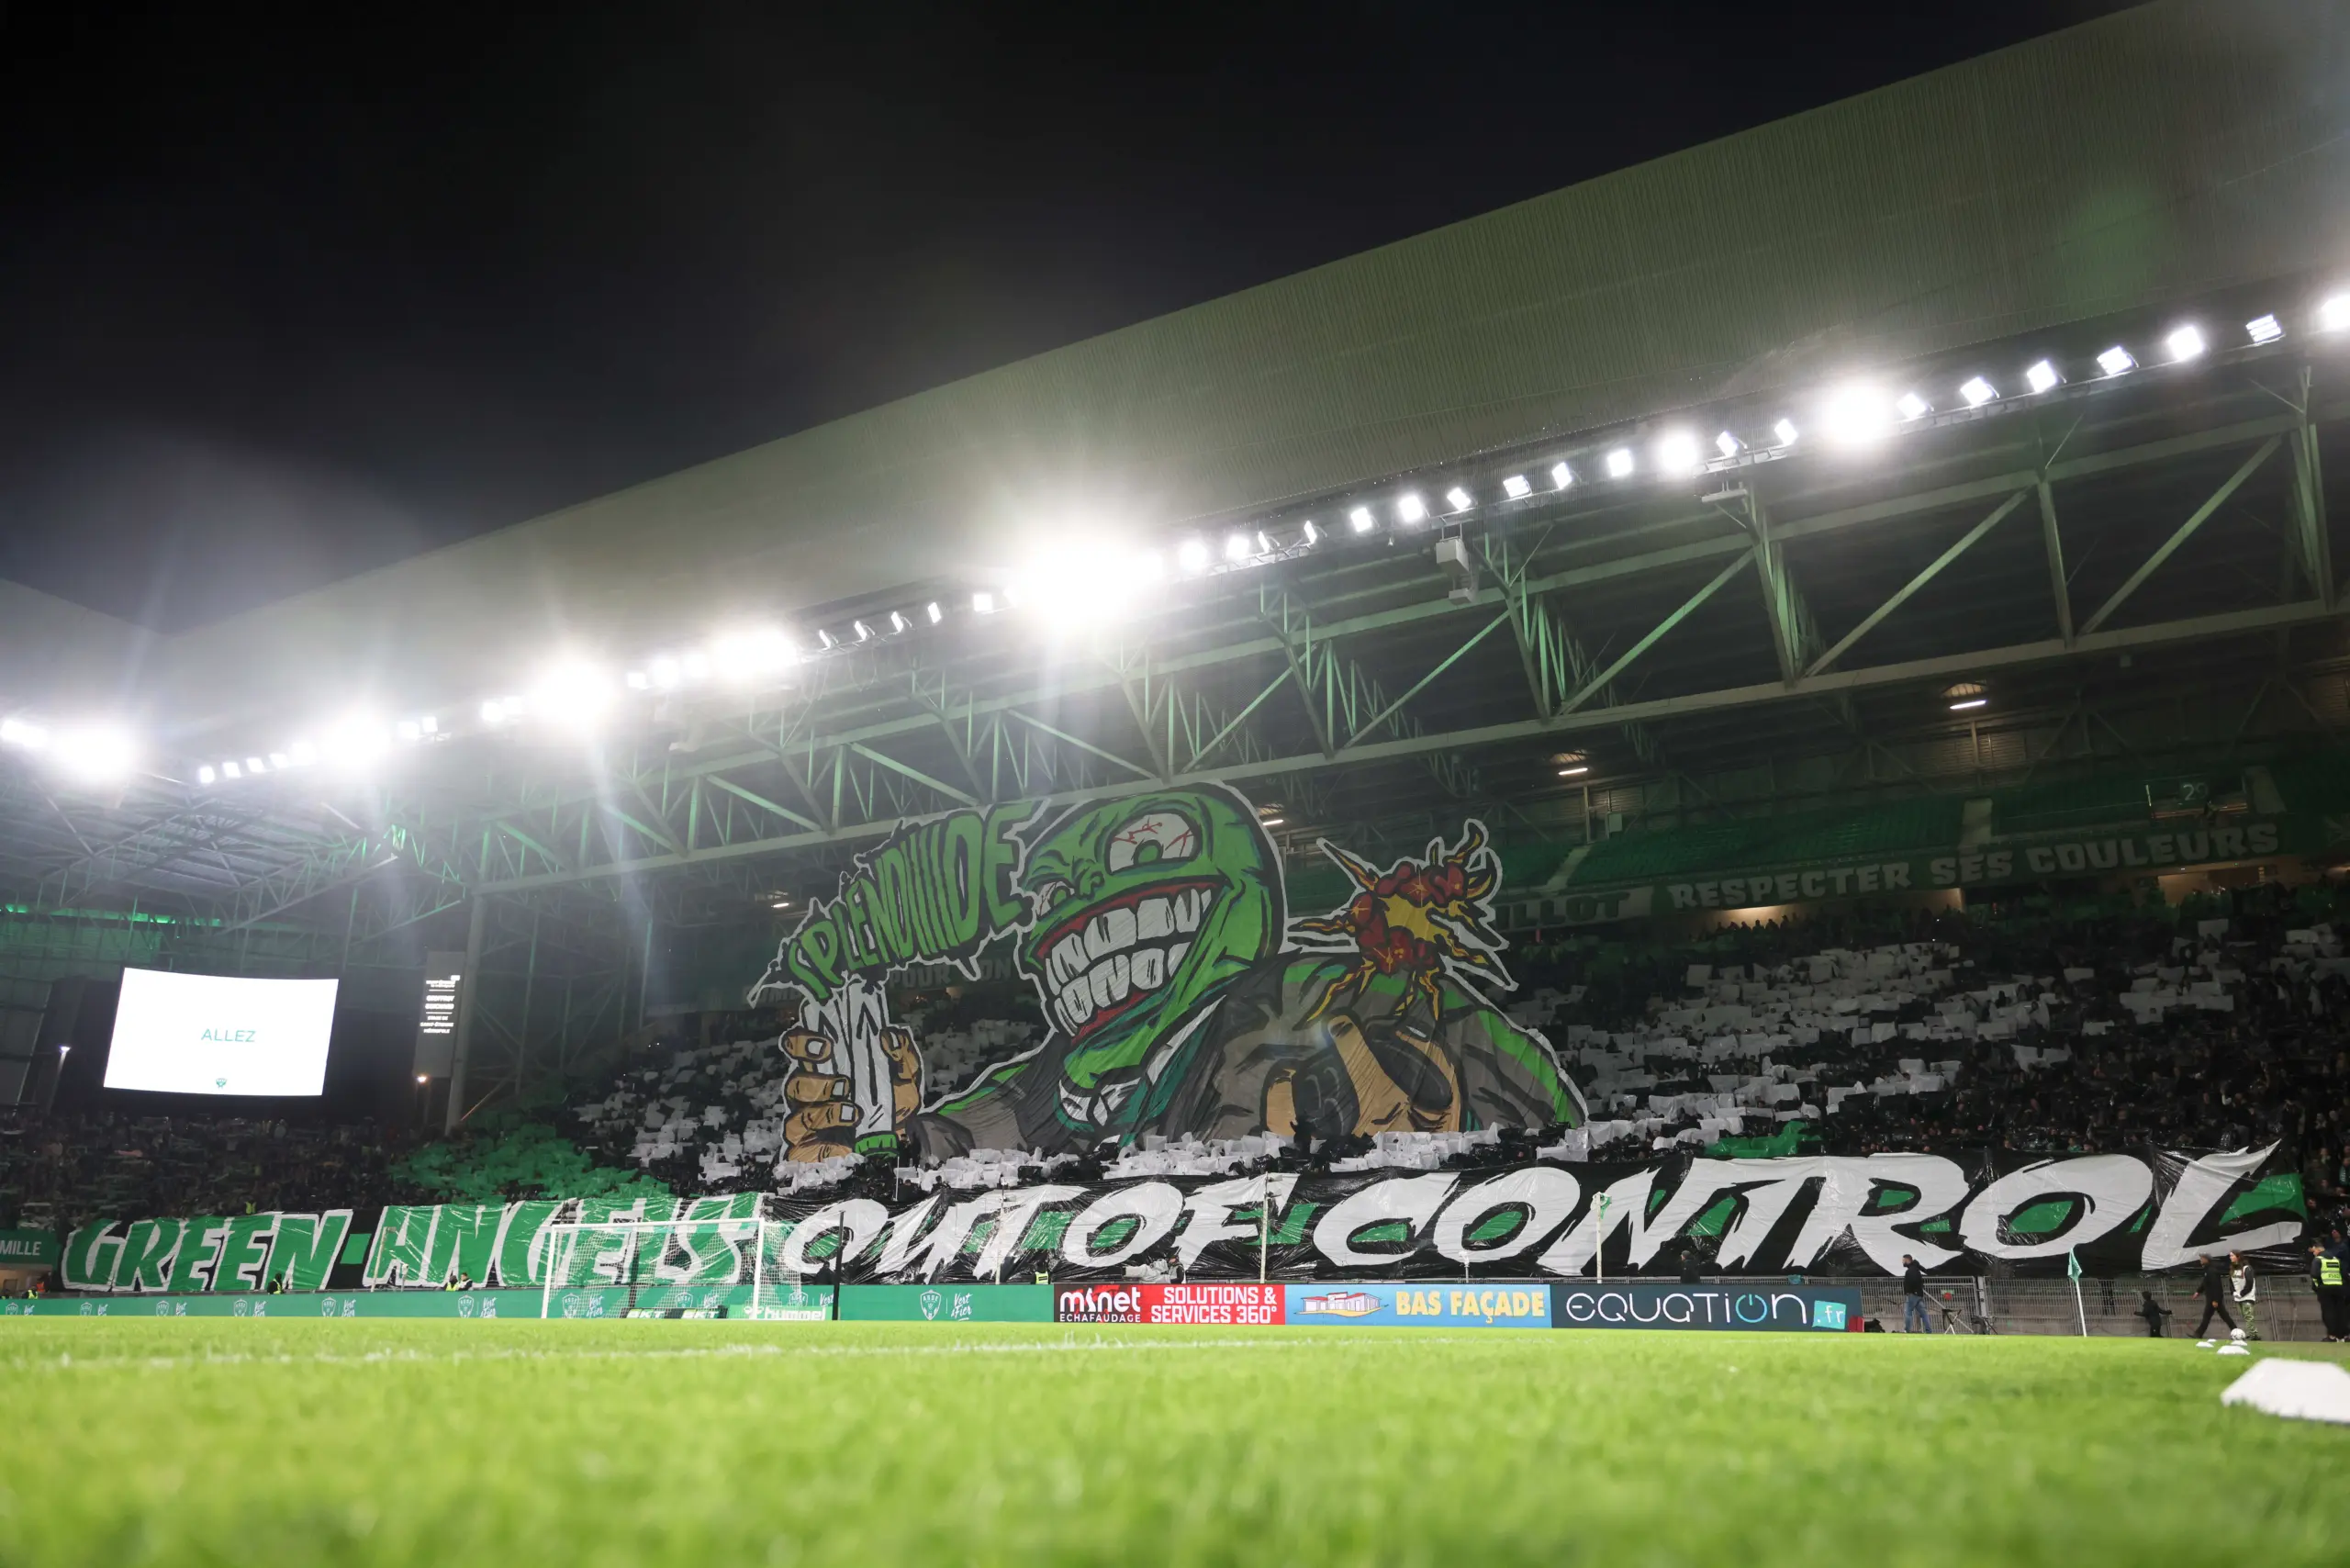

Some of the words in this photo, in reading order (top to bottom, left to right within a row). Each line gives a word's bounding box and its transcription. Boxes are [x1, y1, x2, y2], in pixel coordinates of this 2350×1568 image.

[1666, 862, 1912, 911] RESPECTER
[1930, 850, 2014, 887] SES
[2025, 824, 2279, 875] COULEURS
[889, 964, 952, 990] POUR
[200, 1027, 256, 1043] ALLEZ
[1313, 1139, 2304, 1277] CONTROL
[954, 1292, 973, 1307] Vert
[1163, 1286, 1259, 1305] SOLUTIONS
[1264, 1287, 1278, 1305] &
[1150, 1305, 1231, 1324] SERVICES
[1236, 1305, 1278, 1324] 360°
[1395, 1290, 1442, 1316] BAS
[1449, 1290, 1546, 1324] FAÇADE
[1059, 1313, 1142, 1323] ECHAFAUDAGE
